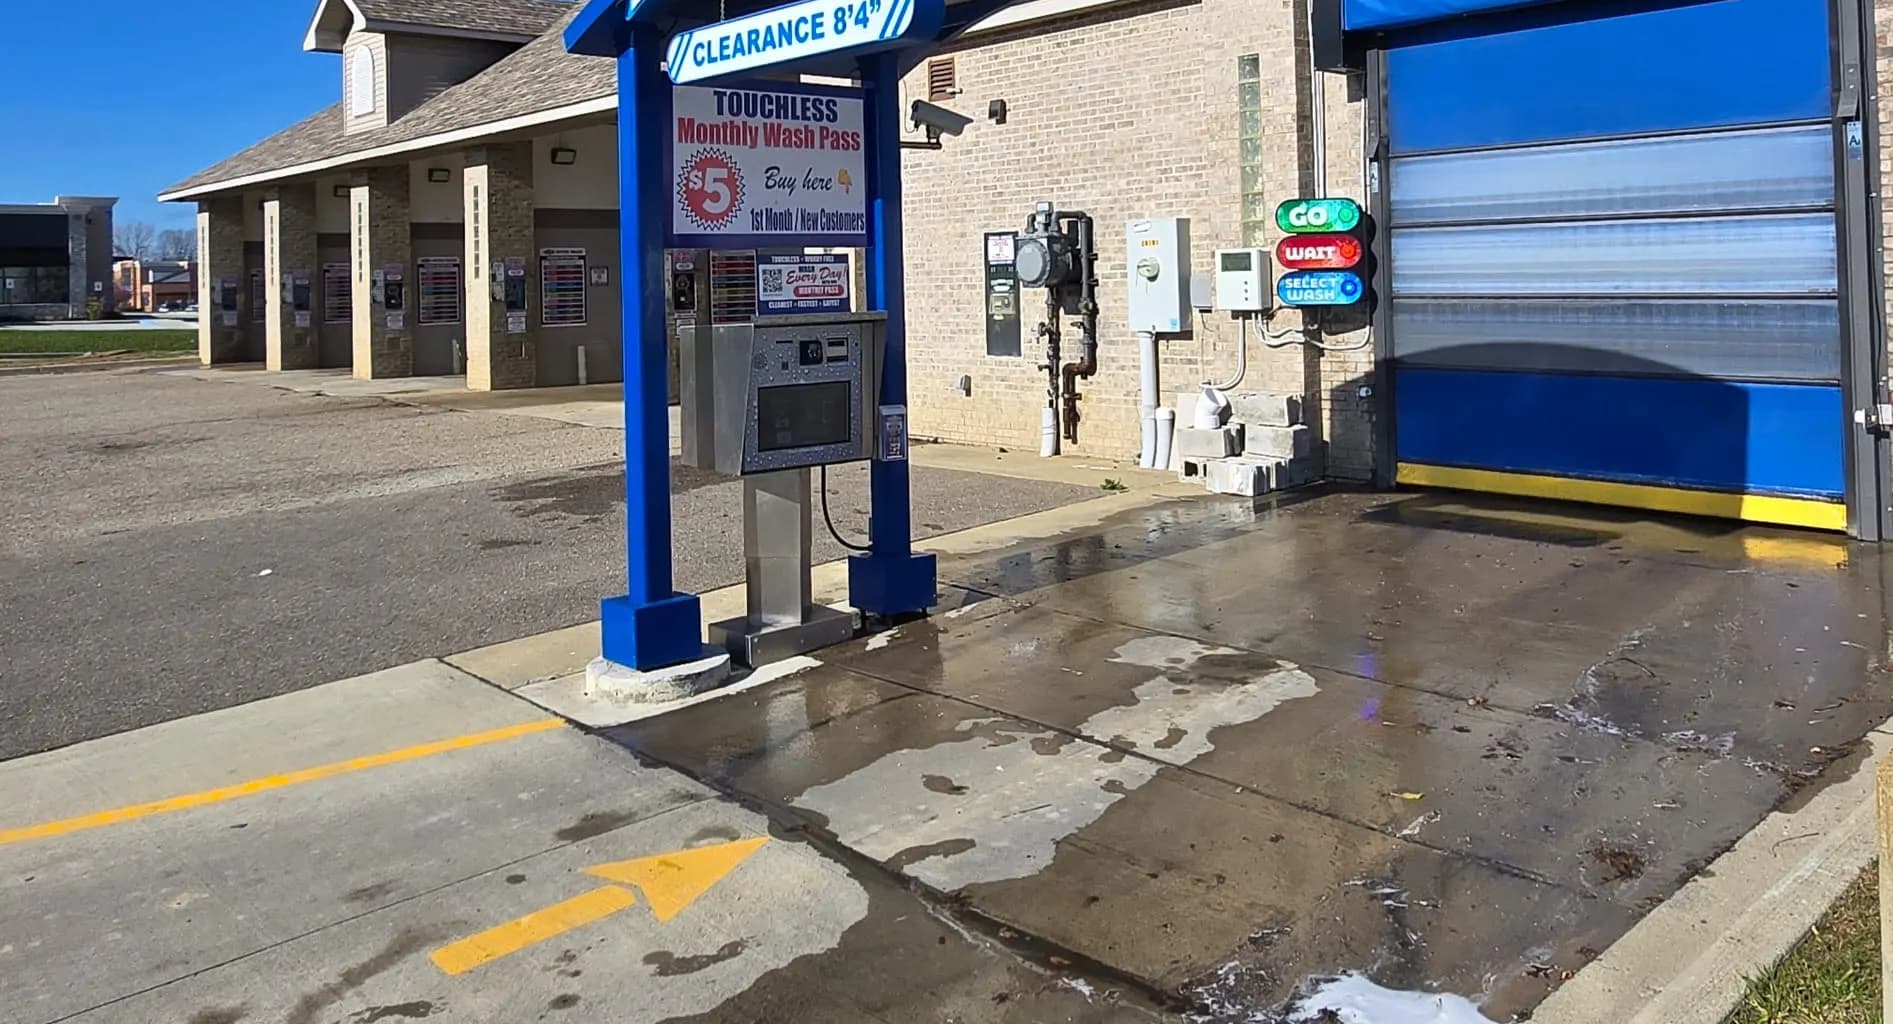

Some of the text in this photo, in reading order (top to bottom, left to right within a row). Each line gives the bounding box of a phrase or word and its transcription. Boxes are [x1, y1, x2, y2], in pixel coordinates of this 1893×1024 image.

[693, 12, 825, 66] CLEARANCE
[713, 90, 838, 123] TOUCHLESS
[677, 117, 861, 151] Monthly Wash Pass
[688, 167, 731, 214] $5
[764, 166, 833, 196] Buy here
[750, 208, 763, 231] 1st
[765, 208, 792, 231] Month
[800, 209, 819, 231] New
[819, 209, 865, 232] Customers
[1289, 204, 1328, 227] GO
[1285, 246, 1336, 261] WAIT
[786, 265, 848, 284] Every Day!
[1285, 278, 1338, 289] SELECT
[1286, 289, 1335, 301] WASH
